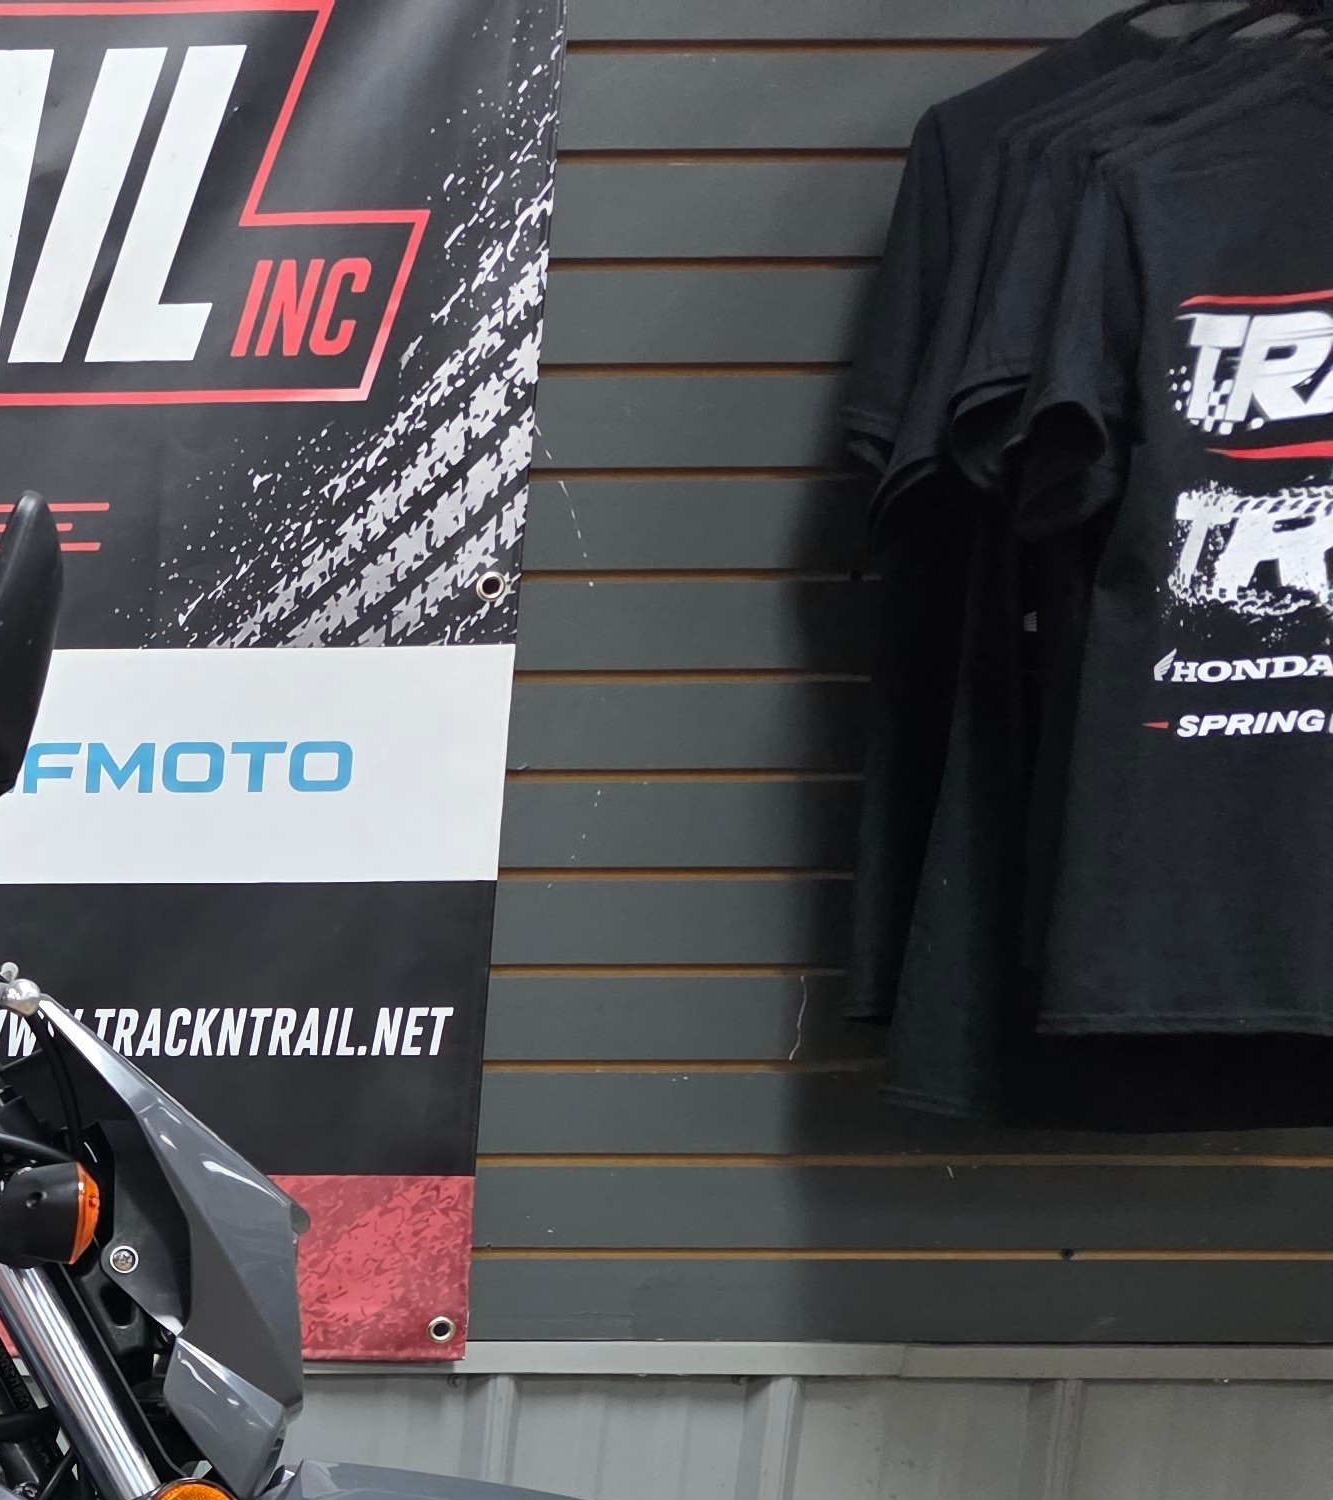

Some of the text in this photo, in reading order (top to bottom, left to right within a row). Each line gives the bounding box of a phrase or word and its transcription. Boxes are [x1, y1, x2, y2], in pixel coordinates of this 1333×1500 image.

[231, 256, 370, 358] INC
[1170, 654, 1333, 683] HONDA
[1176, 708, 1326, 738] SPRING
